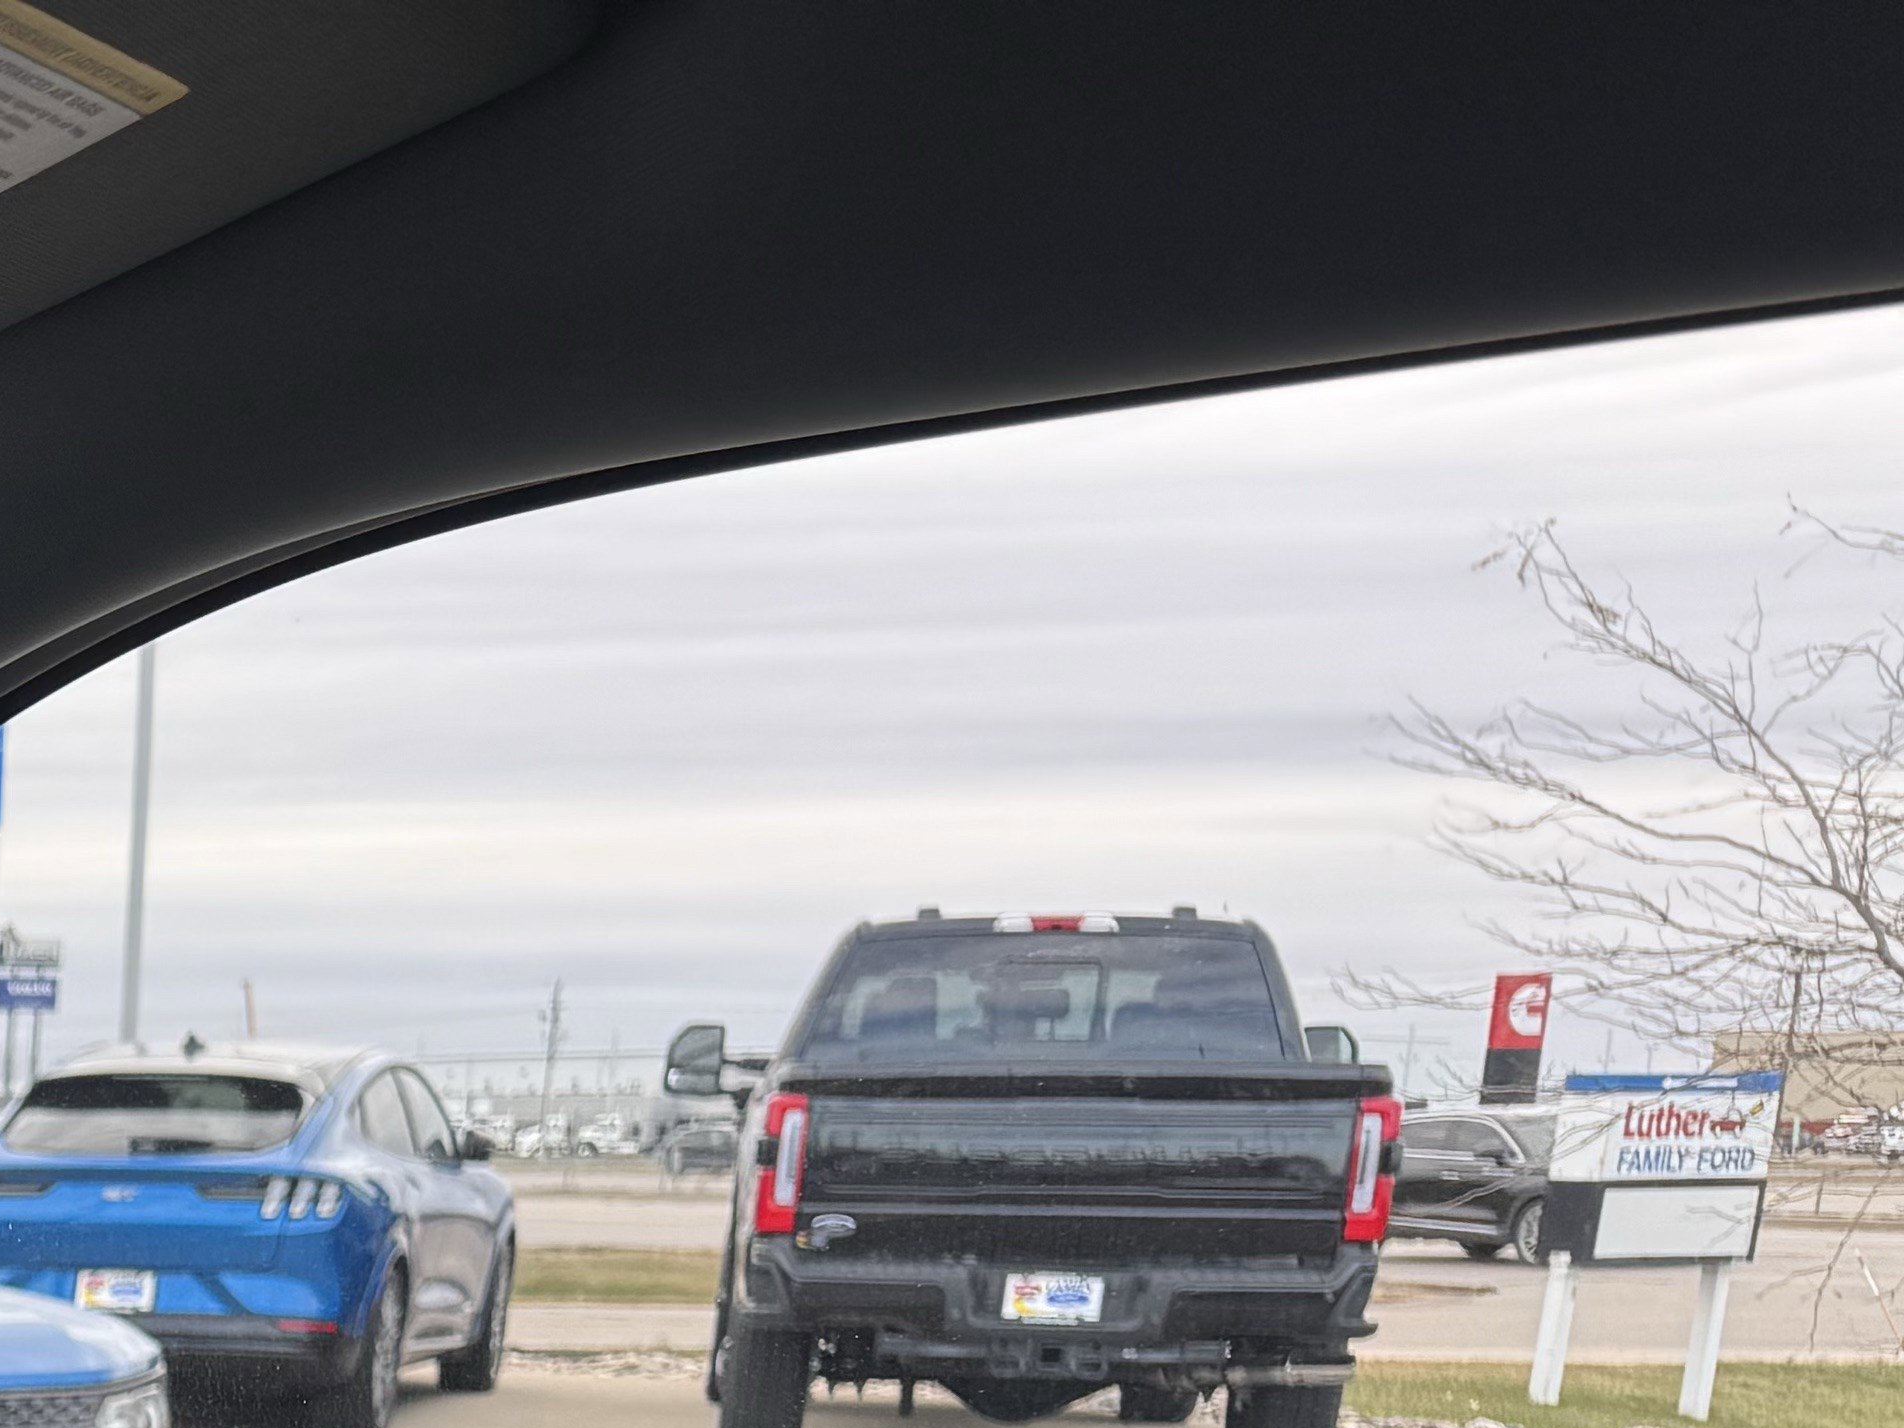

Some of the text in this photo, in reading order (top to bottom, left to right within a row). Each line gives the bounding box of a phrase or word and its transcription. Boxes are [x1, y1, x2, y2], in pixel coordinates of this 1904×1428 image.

[1623, 1103, 1710, 1139] Luther
[1617, 1145, 1755, 1175] FAMILY FORD
